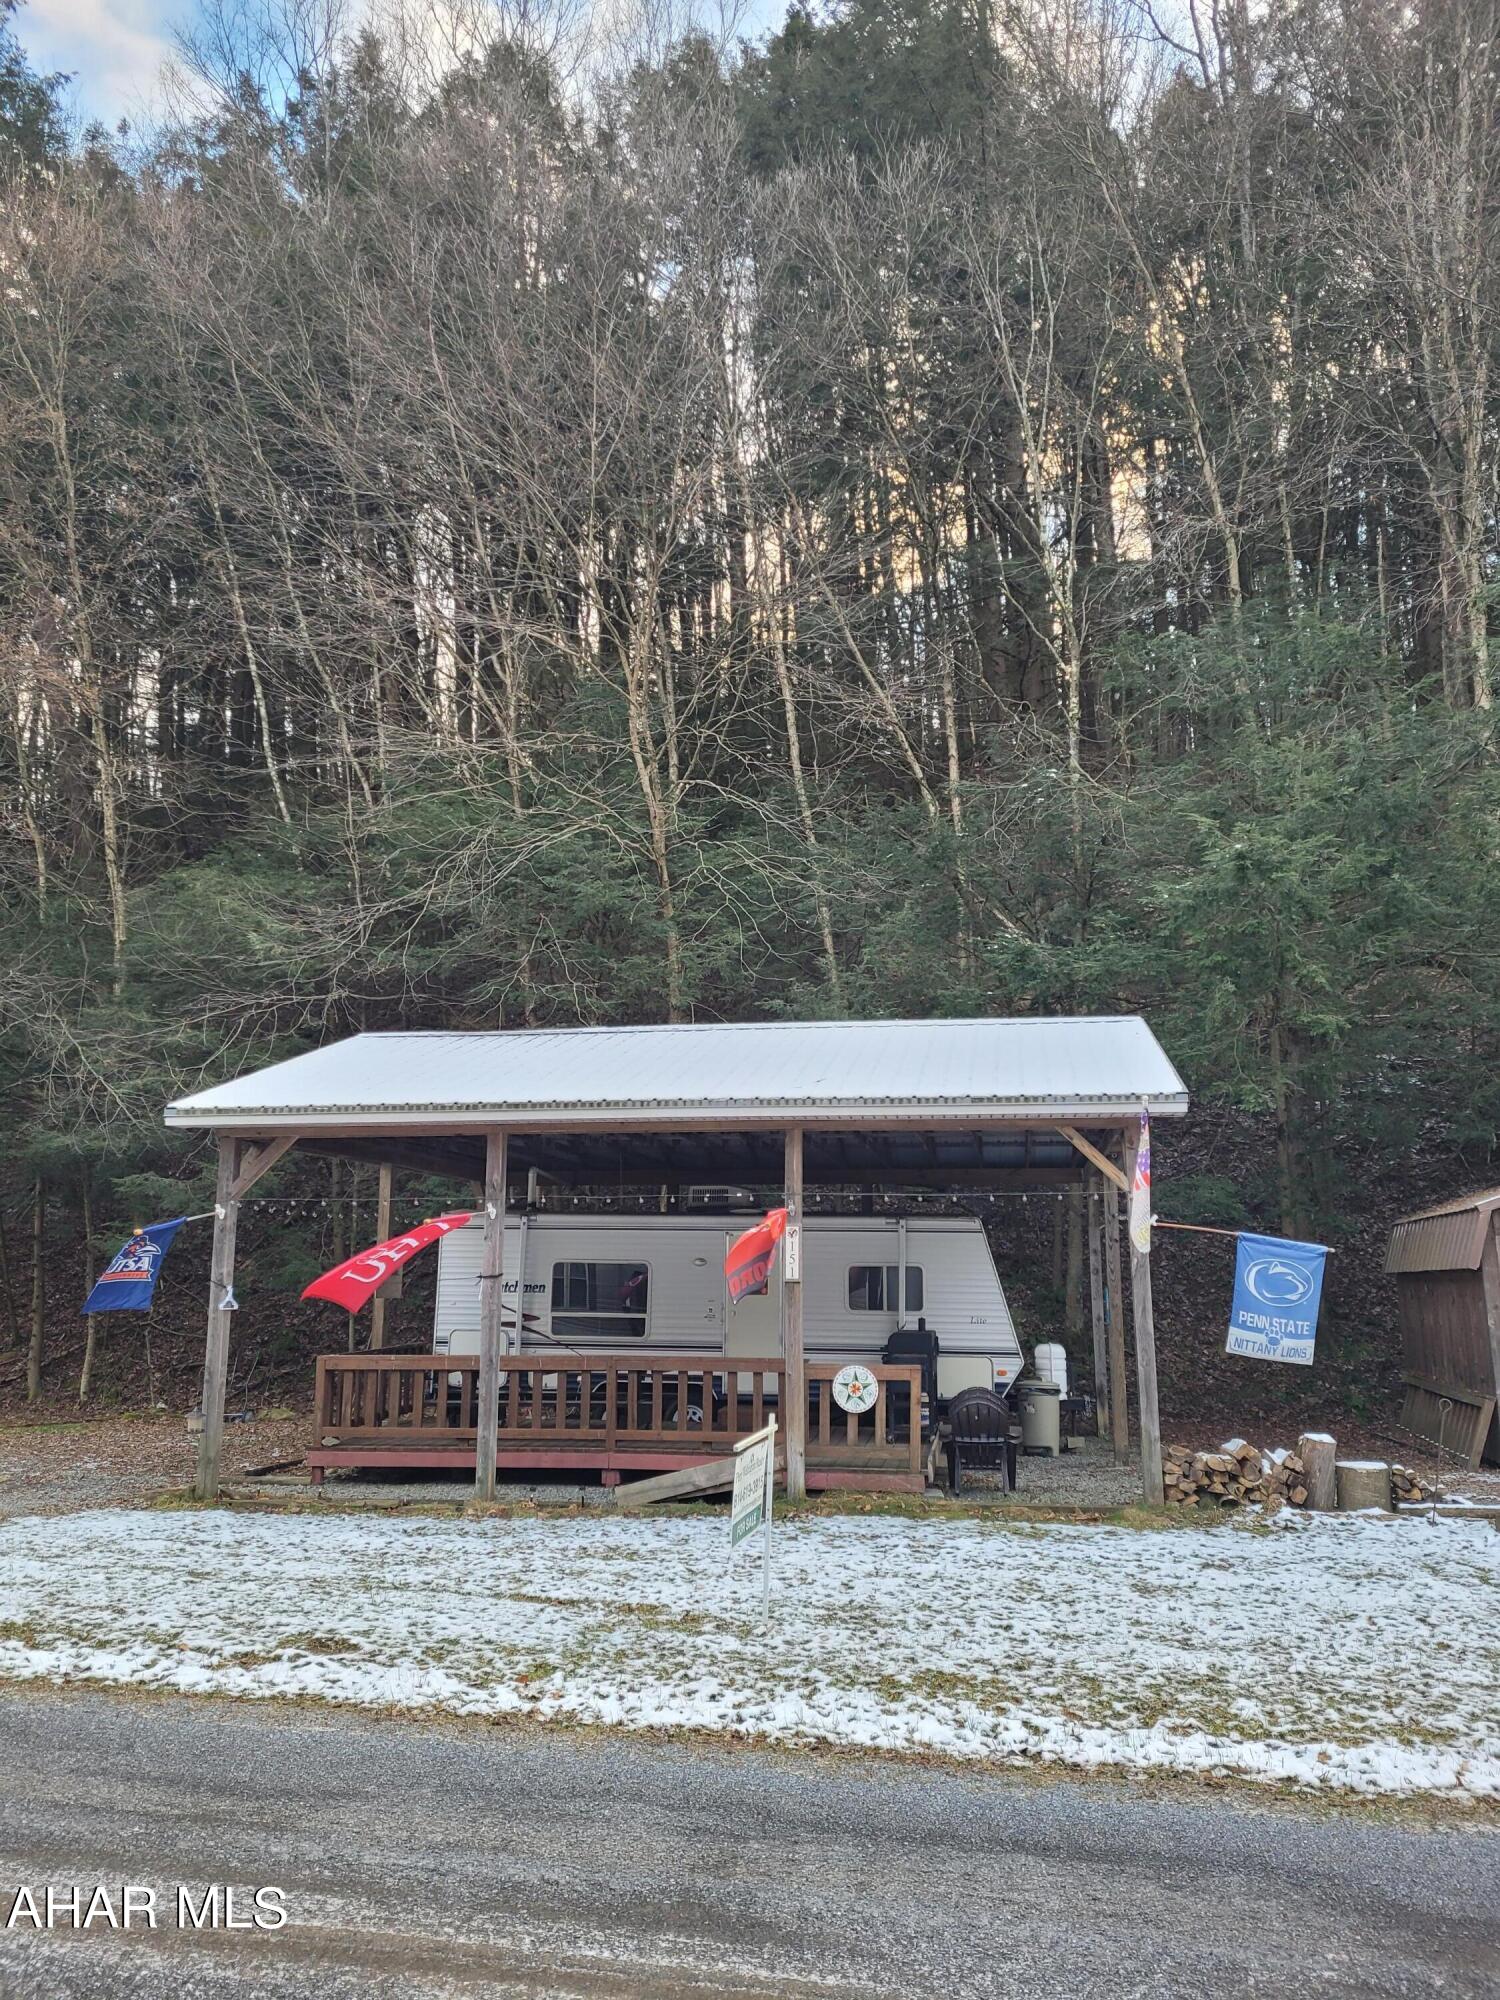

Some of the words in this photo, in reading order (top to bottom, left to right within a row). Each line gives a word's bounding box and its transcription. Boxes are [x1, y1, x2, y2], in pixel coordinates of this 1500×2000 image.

[1238, 1310, 1270, 1330] PENN
[1272, 1317, 1311, 1335] STATE
[1233, 1337, 1279, 1357] NITTANY
[1280, 1347, 1308, 1359] LIONS
